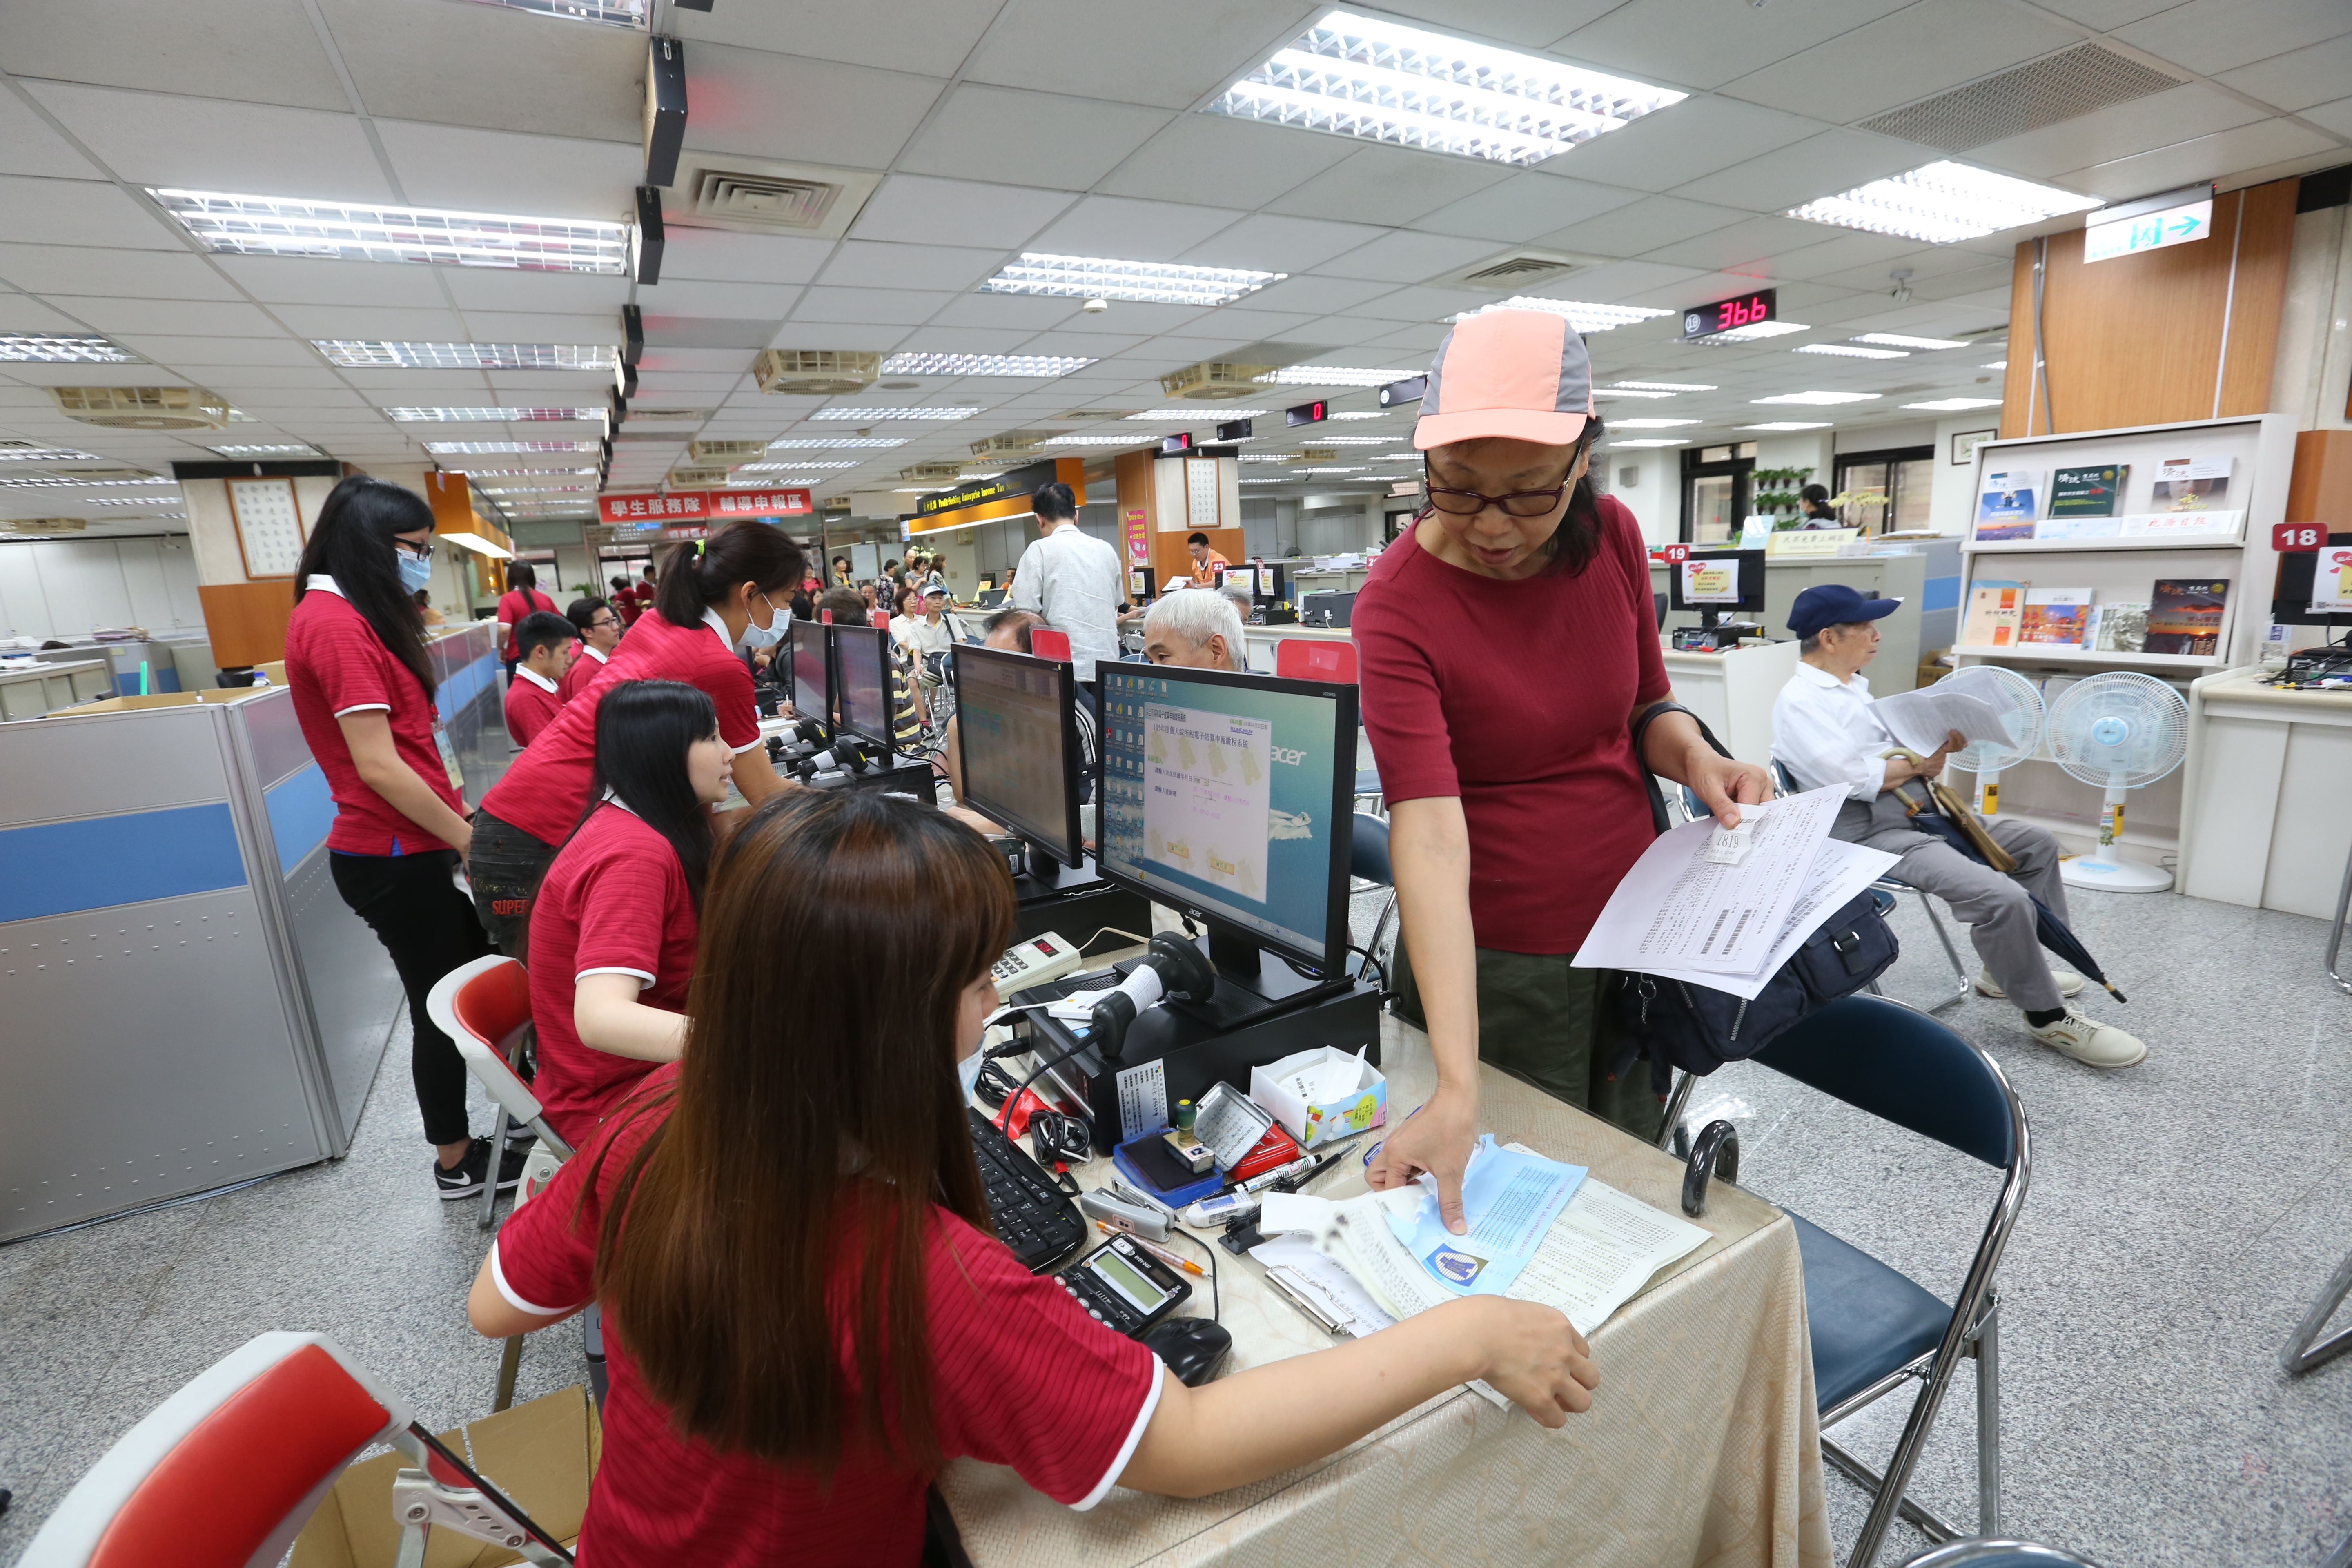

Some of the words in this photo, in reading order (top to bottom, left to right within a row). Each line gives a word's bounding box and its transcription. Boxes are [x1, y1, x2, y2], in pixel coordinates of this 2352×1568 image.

[1717, 297, 1767, 330] 366
[1313, 403, 1321, 421] 0
[1181, 434, 1187, 448] 0
[719, 493, 803, 512] 輔導申報區
[938, 496, 961, 508] Profit-Seeking
[962, 490, 980, 501] Enterprise
[981, 486, 995, 497] Income
[996, 483, 1004, 493] Tax
[610, 497, 701, 517] 學生服務隊
[2281, 529, 2317, 546] 18
[1668, 548, 1686, 559] 19
[1271, 746, 1307, 766] acer
[1716, 834, 1739, 849] 1819
[1189, 908, 1202, 918] acer
[1103, 1321, 1113, 1329] OFF
